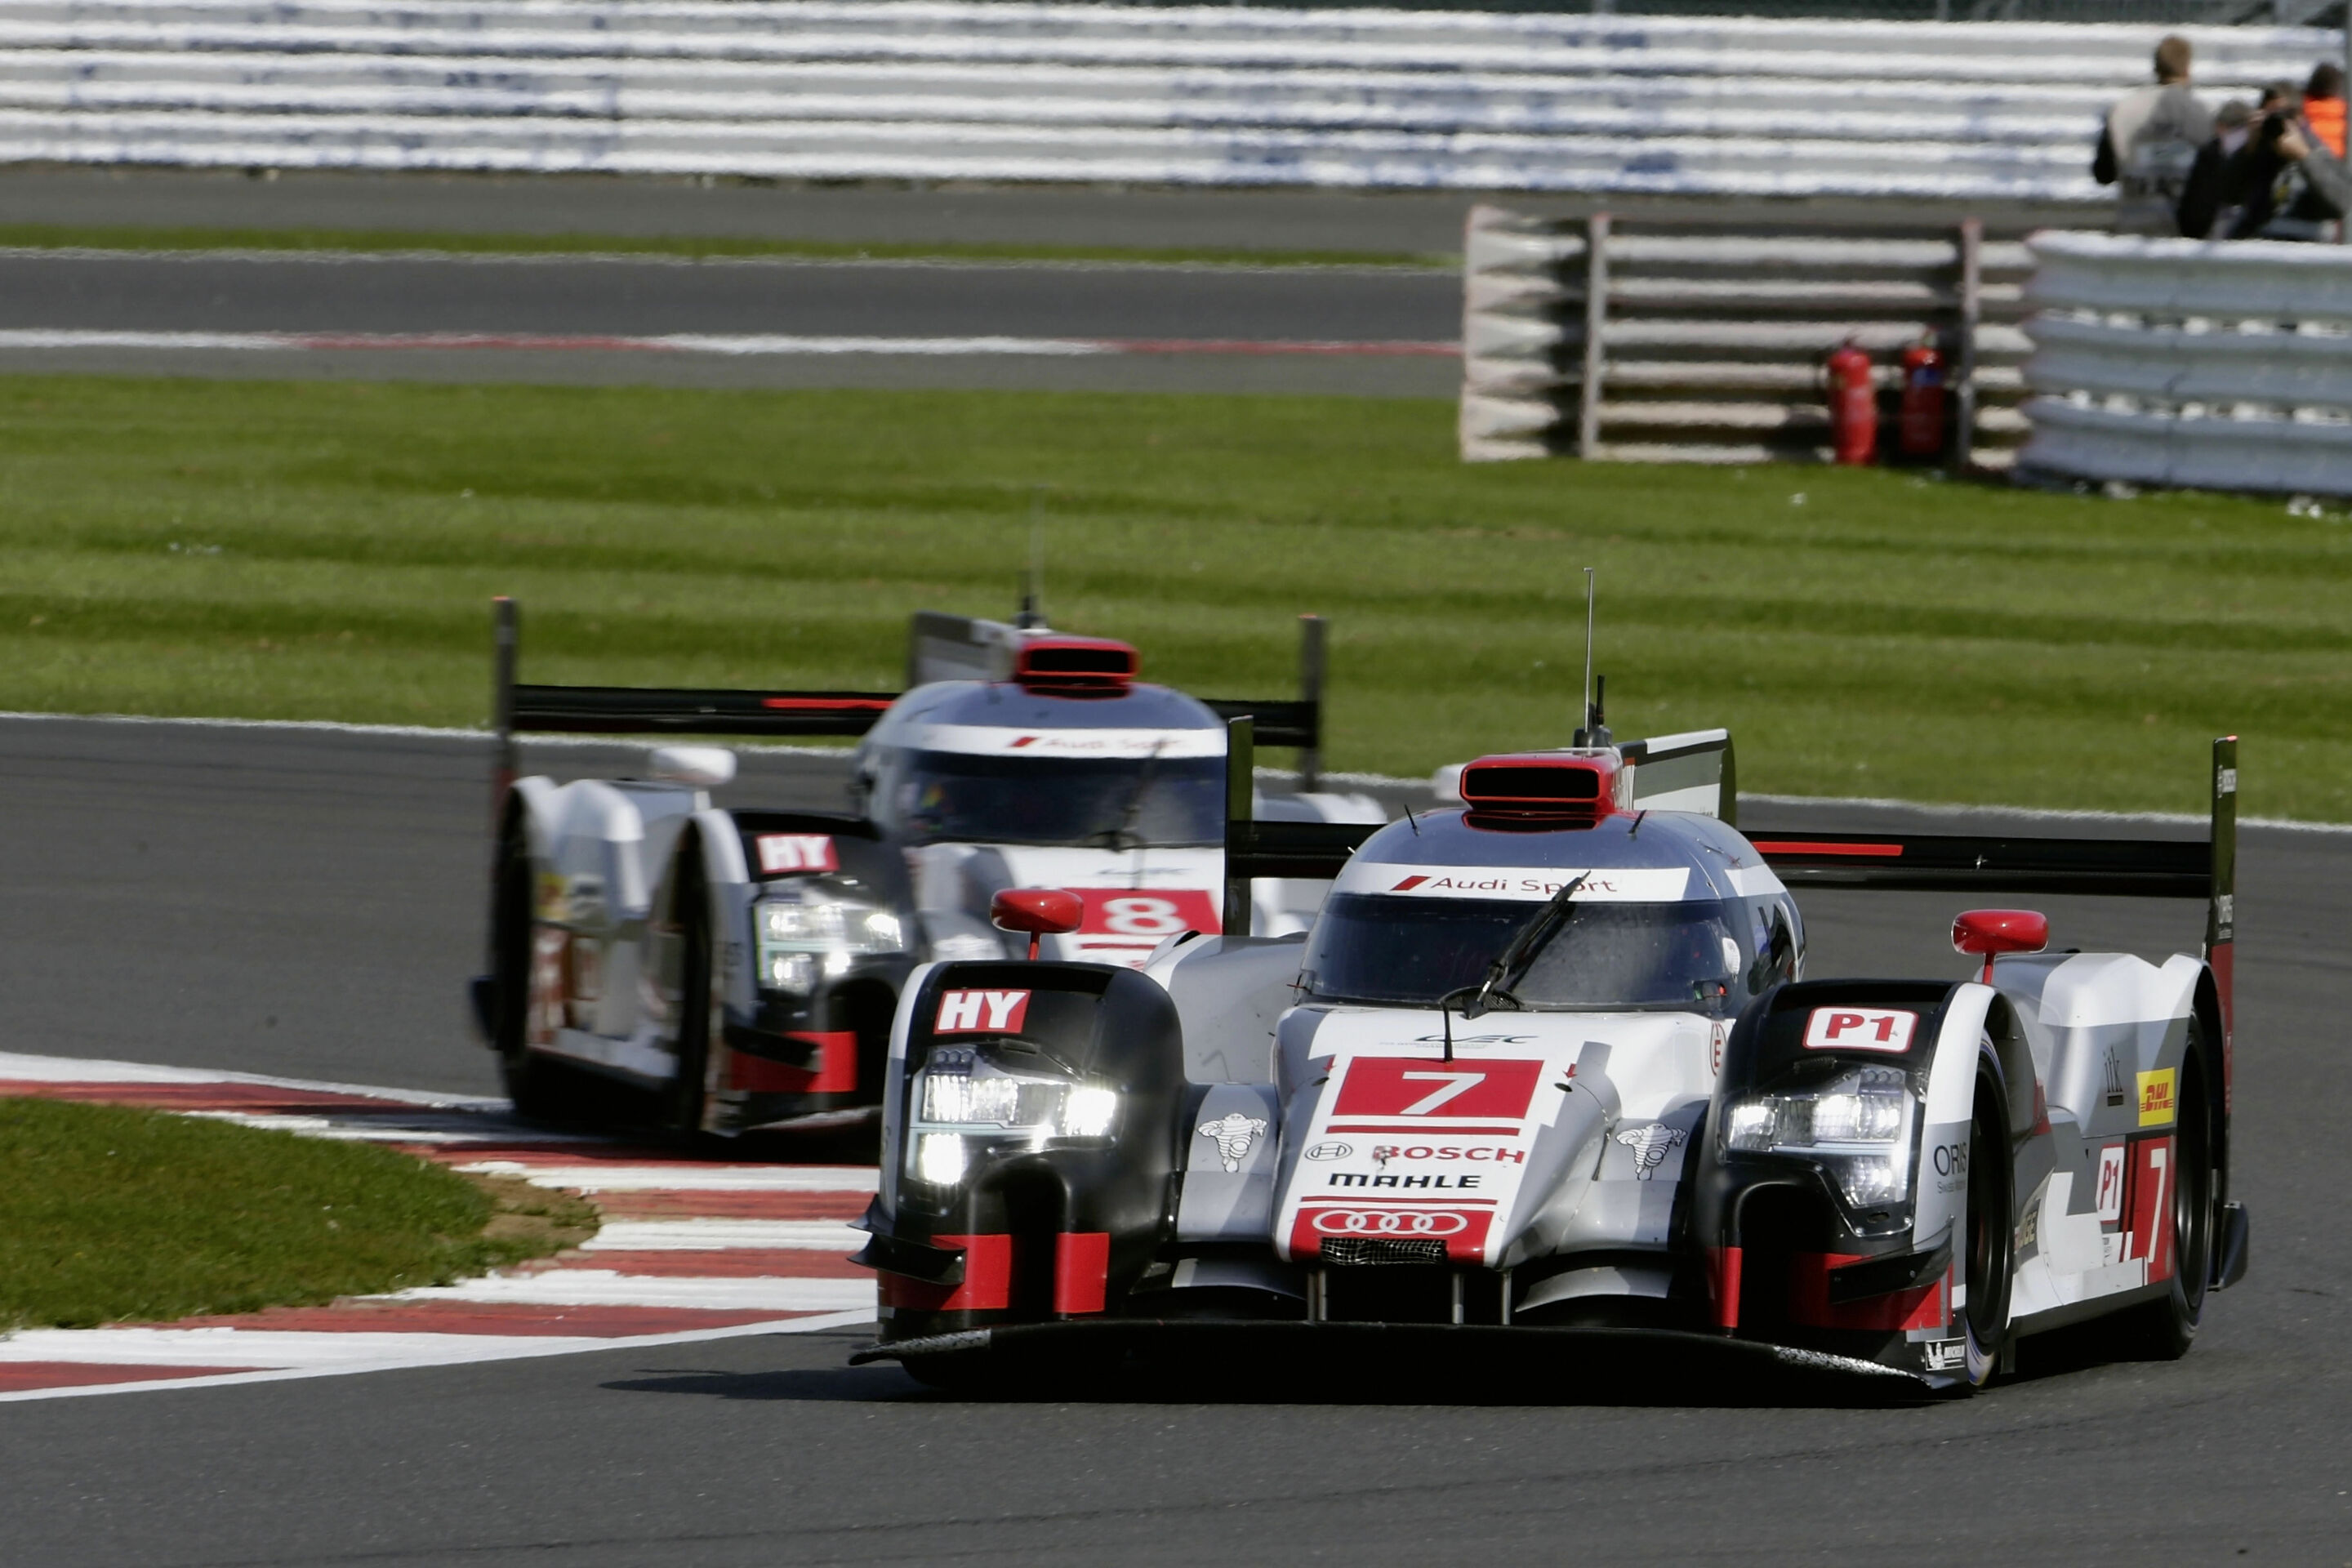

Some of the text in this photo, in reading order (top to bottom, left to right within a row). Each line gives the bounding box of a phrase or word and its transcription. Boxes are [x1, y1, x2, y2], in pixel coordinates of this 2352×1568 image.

[758, 836, 830, 871] HY
[1431, 877, 1507, 891] Audi
[1103, 898, 1187, 934] 8
[938, 991, 1027, 1031] HY
[1824, 1013, 1895, 1041] P1
[1400, 1071, 1486, 1115] 7
[2144, 1082, 2171, 1111] DHL
[1373, 1146, 1526, 1164] BOSCH
[1329, 1173, 1481, 1188] MAHLE
[2099, 1160, 2120, 1209] P1
[2148, 1147, 2167, 1263] 7
